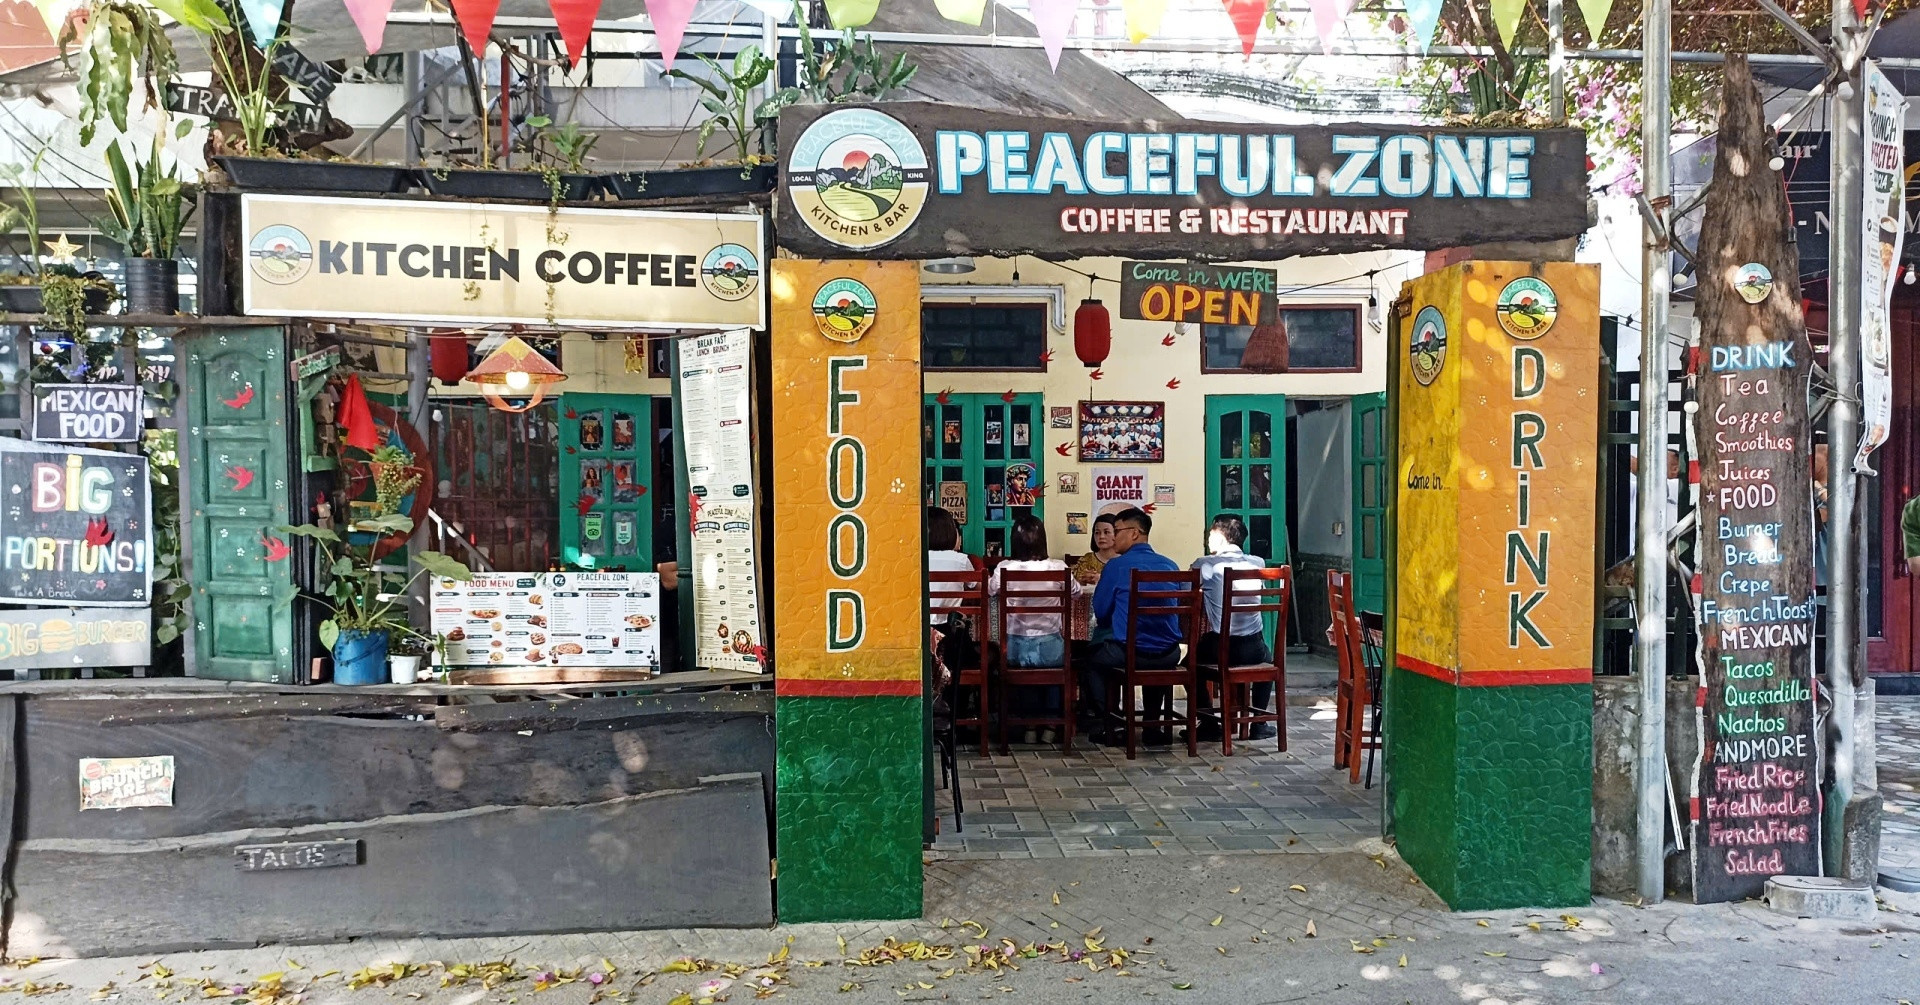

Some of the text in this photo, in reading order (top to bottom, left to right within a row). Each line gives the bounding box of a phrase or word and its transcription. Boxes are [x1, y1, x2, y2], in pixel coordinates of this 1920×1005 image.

[796, 117, 921, 164] PEACEFUL ZONE
[936, 130, 1535, 198] PEACEFUL ZONE
[811, 202, 910, 236] KITCHEN & BAR
[1060, 206, 1409, 235] COFFEE & RESTAURANT
[319, 239, 520, 283] KITCHEN
[535, 249, 697, 288] COFFEE
[1132, 262, 1181, 281] Come
[1188, 267, 1210, 286] in
[710, 282, 734, 296] KITCHEN
[816, 282, 873, 305] PEACEFUL ZONE
[1140, 283, 1261, 326] OPEN
[822, 322, 848, 337] KITCHEN
[1505, 320, 1530, 335] KITCHEN
[1536, 320, 1548, 332] BAR
[697, 338, 713, 348] BREAK
[714, 335, 727, 345] FAST
[1711, 341, 1796, 370] DRINK
[1720, 374, 1769, 396] Tea
[40, 389, 135, 413] MEXICAN
[59, 412, 126, 439] FOOD
[1715, 403, 1783, 433] Coffee
[1715, 430, 1795, 454] Smoothies
[1095, 475, 1144, 489] GIANT
[1408, 463, 1430, 489] Come
[1719, 460, 1770, 480] Juices
[826, 355, 868, 653] FOOD
[942, 496, 965, 508] PIZZA
[1096, 489, 1143, 501] BURGER
[1720, 483, 1776, 510] FOOD
[1719, 517, 1784, 540] Burger
[1725, 539, 1783, 566] Bread
[464, 579, 487, 588] FOOD
[490, 579, 515, 588] MENU
[577, 573, 629, 581] PEACEFUL ZONE
[1720, 571, 1770, 597] Crepe
[11, 585, 33, 597] Take
[48, 587, 77, 598] Break
[76, 620, 147, 646] BURGER
[1721, 623, 1808, 650] MEXICAN
[1722, 656, 1774, 679] Tacos
[1725, 680, 1811, 706] Quesadilla
[1718, 711, 1785, 734] Nachos
[1725, 850, 1784, 875] Salad
